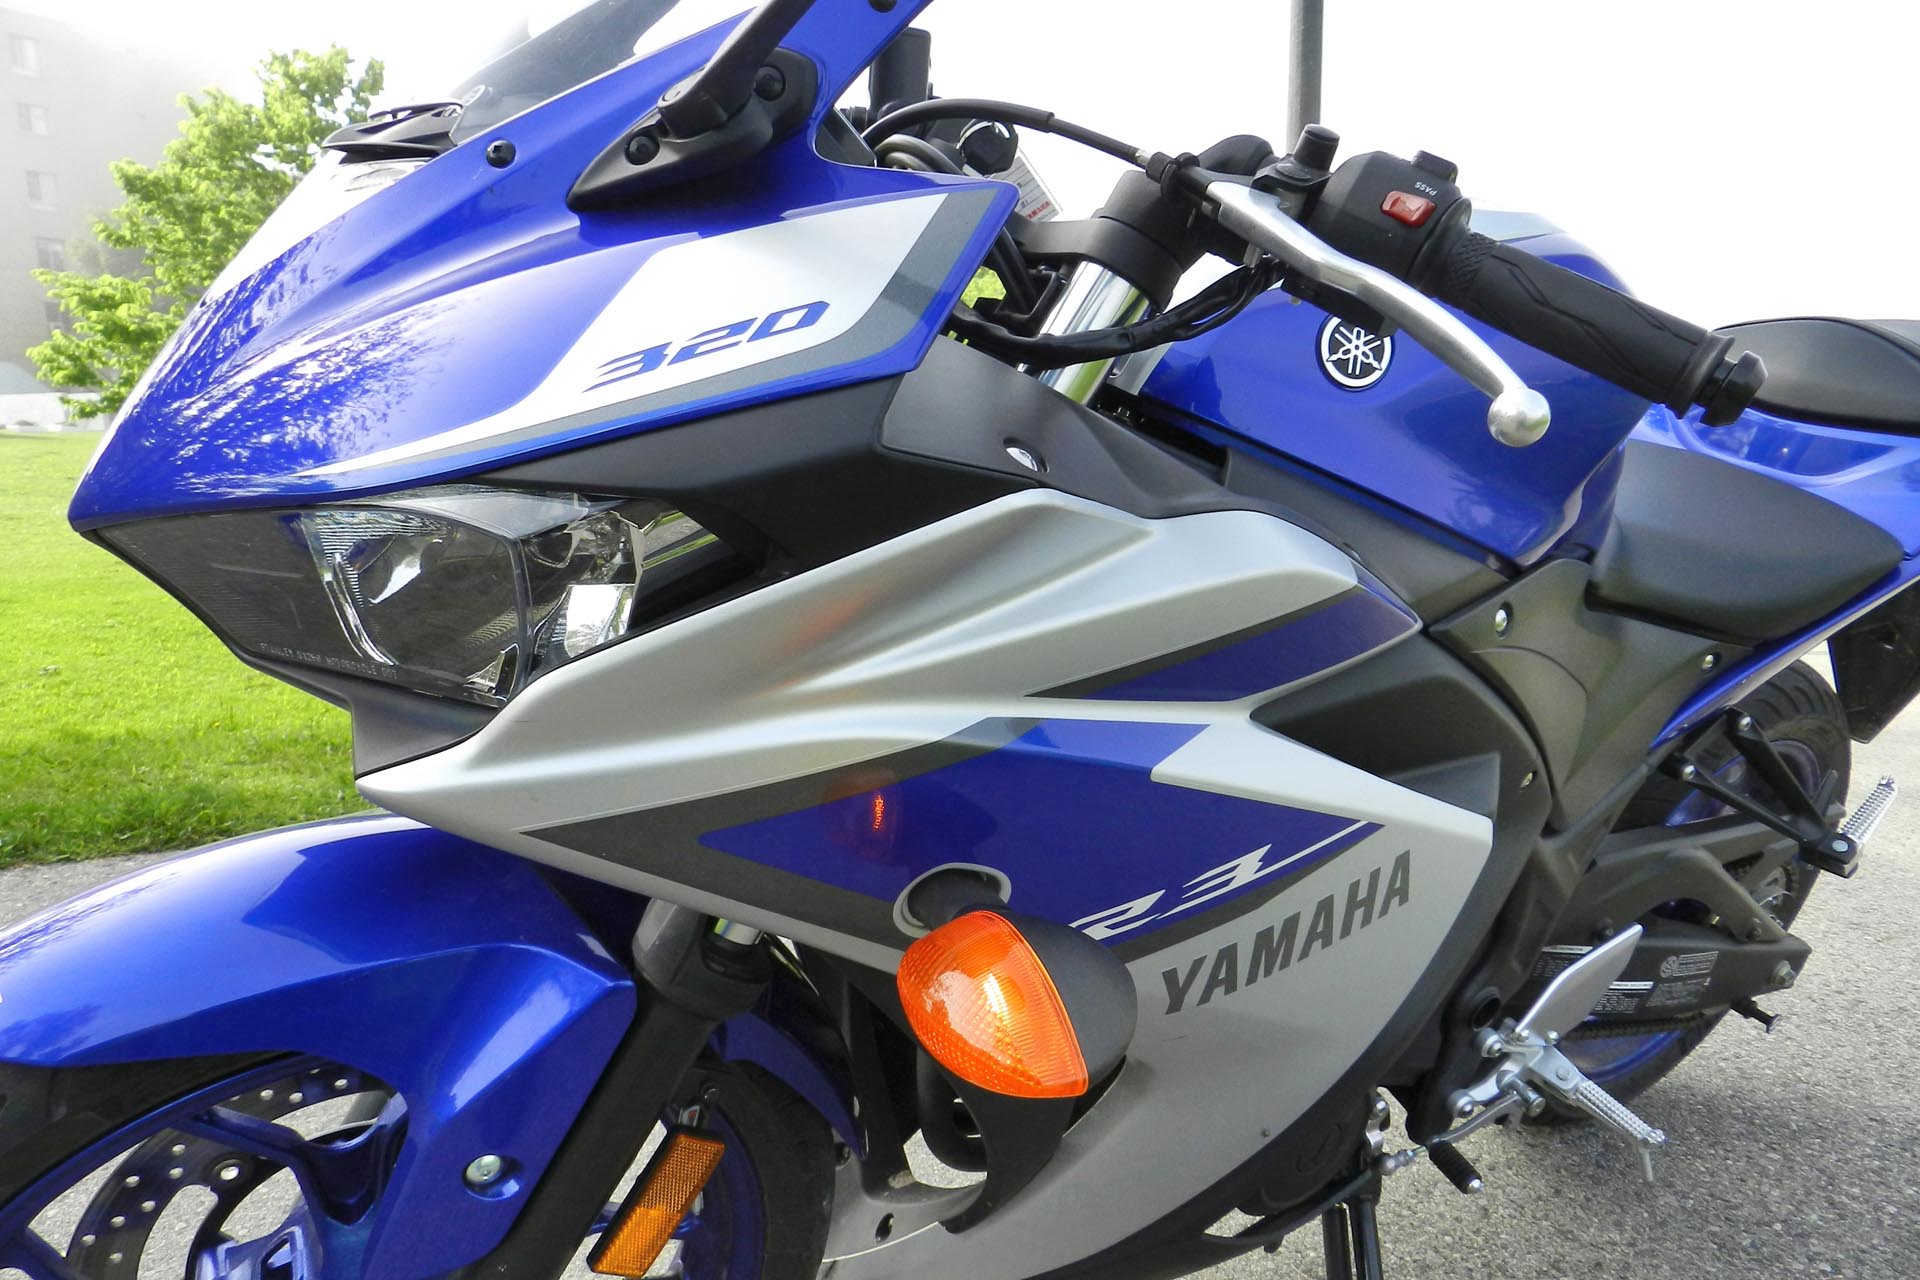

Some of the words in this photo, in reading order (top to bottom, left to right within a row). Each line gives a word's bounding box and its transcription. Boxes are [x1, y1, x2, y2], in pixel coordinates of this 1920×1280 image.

[1414, 181, 1439, 196] PASS
[581, 300, 831, 393] 320
[1161, 848, 1411, 1016] YAMAHA
